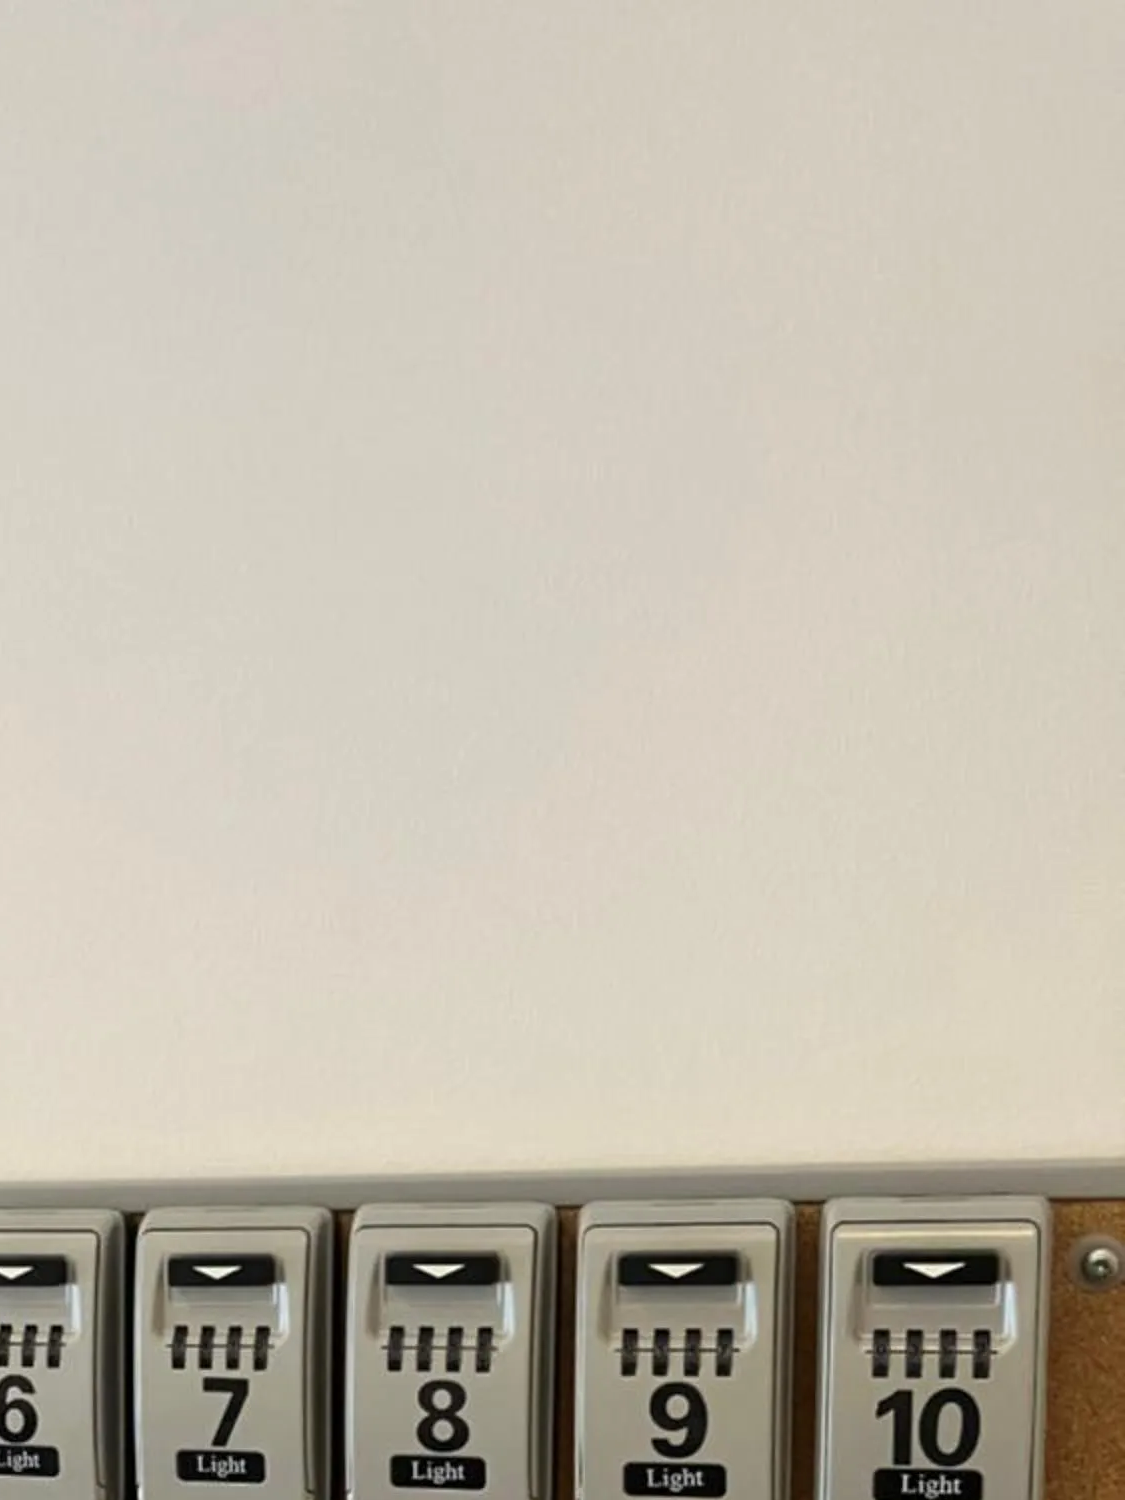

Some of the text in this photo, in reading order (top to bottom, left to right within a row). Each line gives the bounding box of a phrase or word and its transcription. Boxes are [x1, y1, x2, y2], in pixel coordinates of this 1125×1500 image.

[202, 1378, 249, 1447] 7
[416, 1380, 469, 1452] 8
[649, 1381, 708, 1458] 9
[876, 1387, 981, 1467] 10
[197, 1455, 247, 1477] Light
[412, 1462, 465, 1484] Light
[646, 1468, 704, 1492] Light
[901, 1475, 962, 1498] Light
